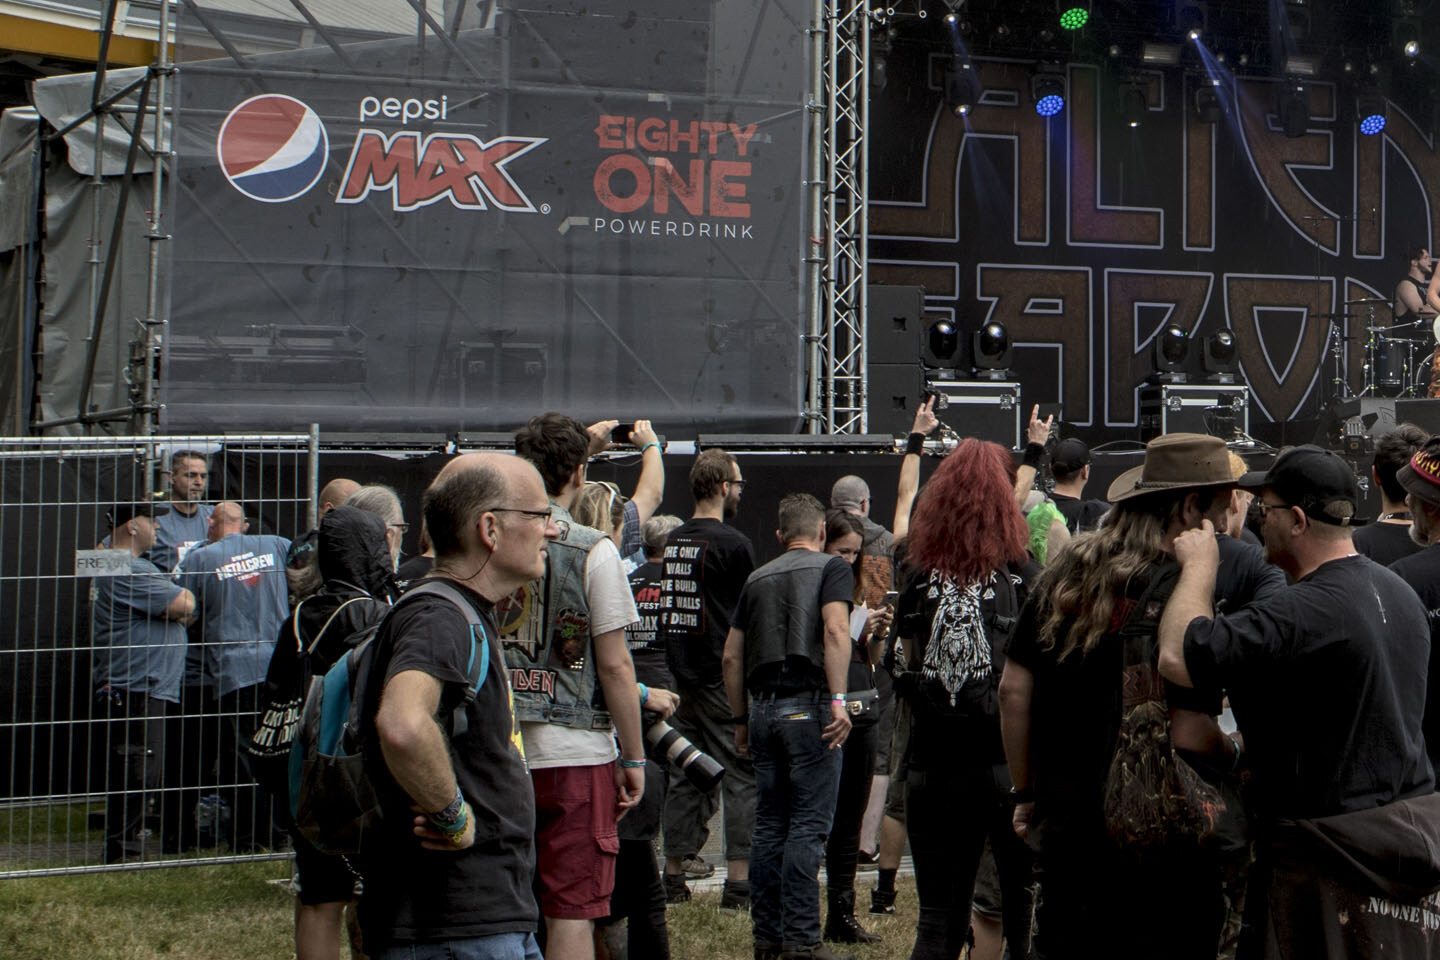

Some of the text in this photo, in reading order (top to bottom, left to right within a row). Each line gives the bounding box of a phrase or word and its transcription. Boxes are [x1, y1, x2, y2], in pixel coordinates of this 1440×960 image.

[360, 95, 448, 124] pepsi
[594, 114, 758, 157] EIGHTY
[335, 129, 550, 213] MAX
[593, 153, 753, 218] ONE
[594, 218, 753, 239] POWERDRINK
[679, 546, 700, 559] ONLY
[666, 562, 692, 575] WALLS
[674, 579, 697, 593] BUILD
[675, 596, 701, 610] WALLS
[508, 668, 558, 701] IDEN
[1391, 903, 1420, 923] ONE
